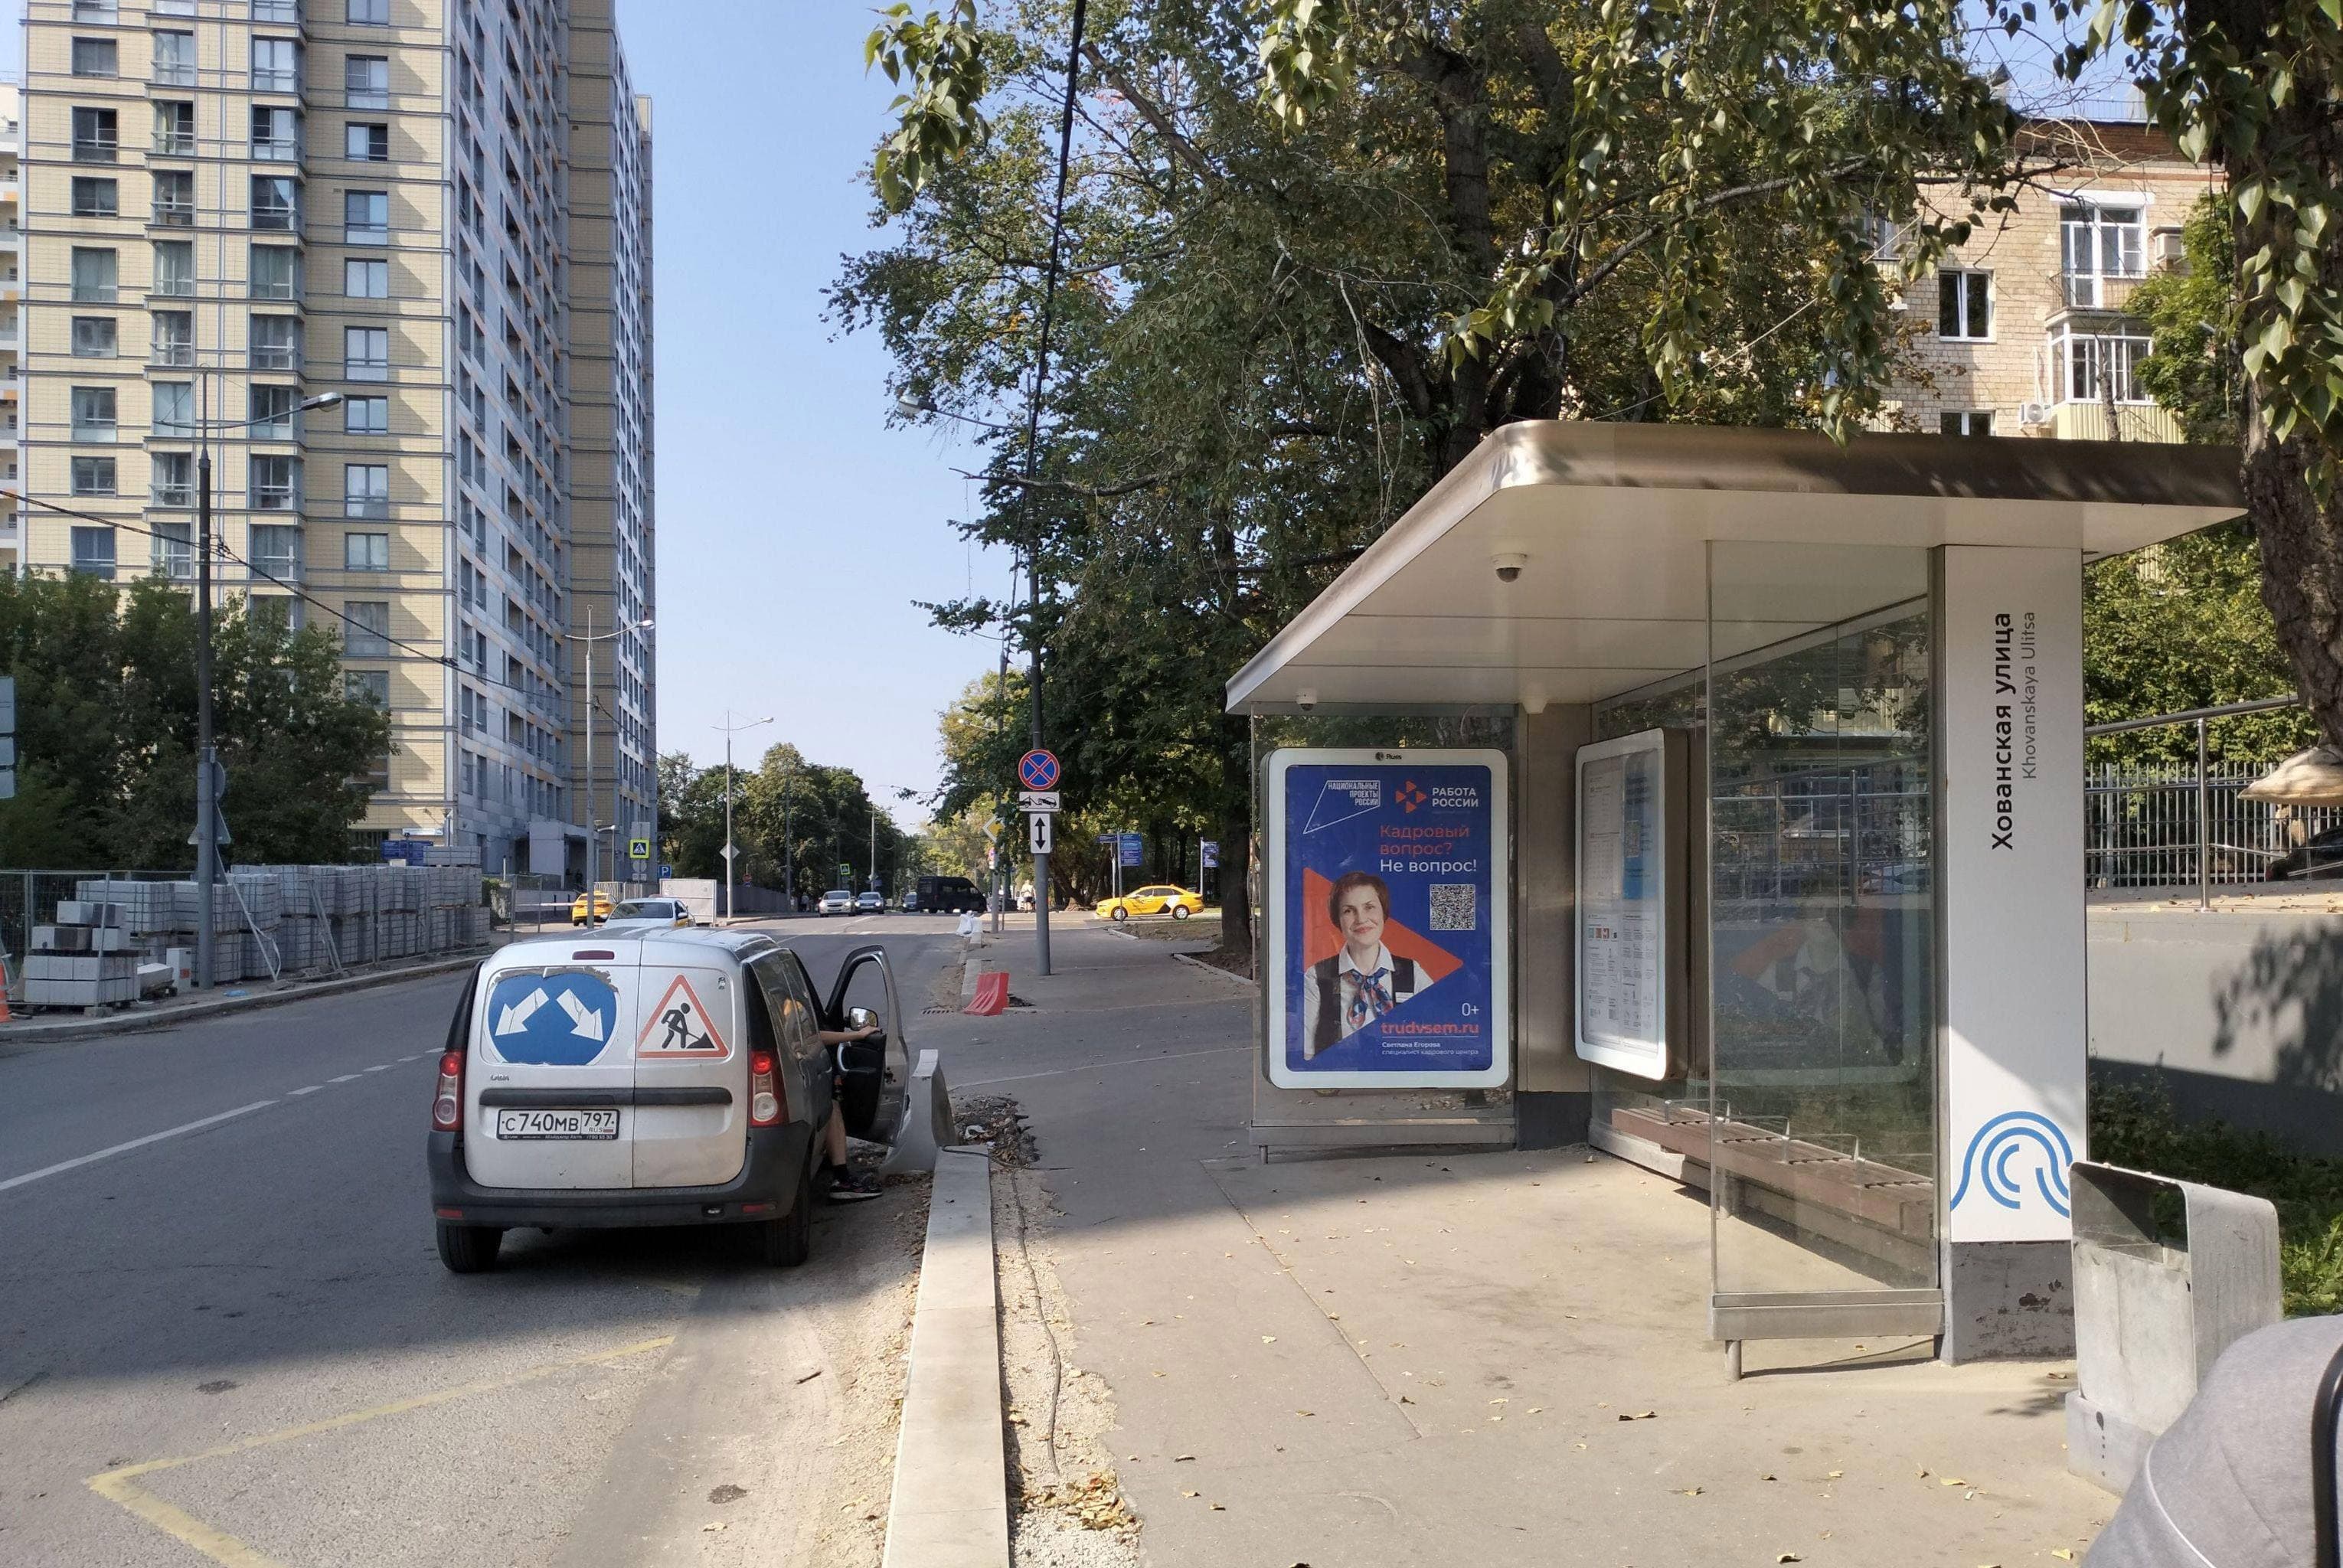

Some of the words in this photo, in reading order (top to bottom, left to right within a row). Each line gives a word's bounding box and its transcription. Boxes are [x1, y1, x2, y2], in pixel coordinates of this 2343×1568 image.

[2021, 612, 2036, 659] Ulitsa
[1995, 612, 2017, 695] улица
[2021, 665, 2039, 779] Khovanskaya
[1991, 704, 2014, 851] Хованская
[1328, 782, 1378, 790] НАЦИОНАЛЬНЫЕ
[1432, 787, 1476, 796] РАБОТА
[1432, 798, 1479, 807] РОССИИ
[1380, 825, 1470, 840] Кадровый
[1380, 842, 1453, 858] вопрос?
[1380, 859, 1402, 872] Не
[1409, 858, 1477, 875] вопрос!
[1461, 1002, 1479, 1016] 0+
[1381, 1021, 1479, 1034] trudvsem.ru
[583, 1112, 613, 1127] 797
